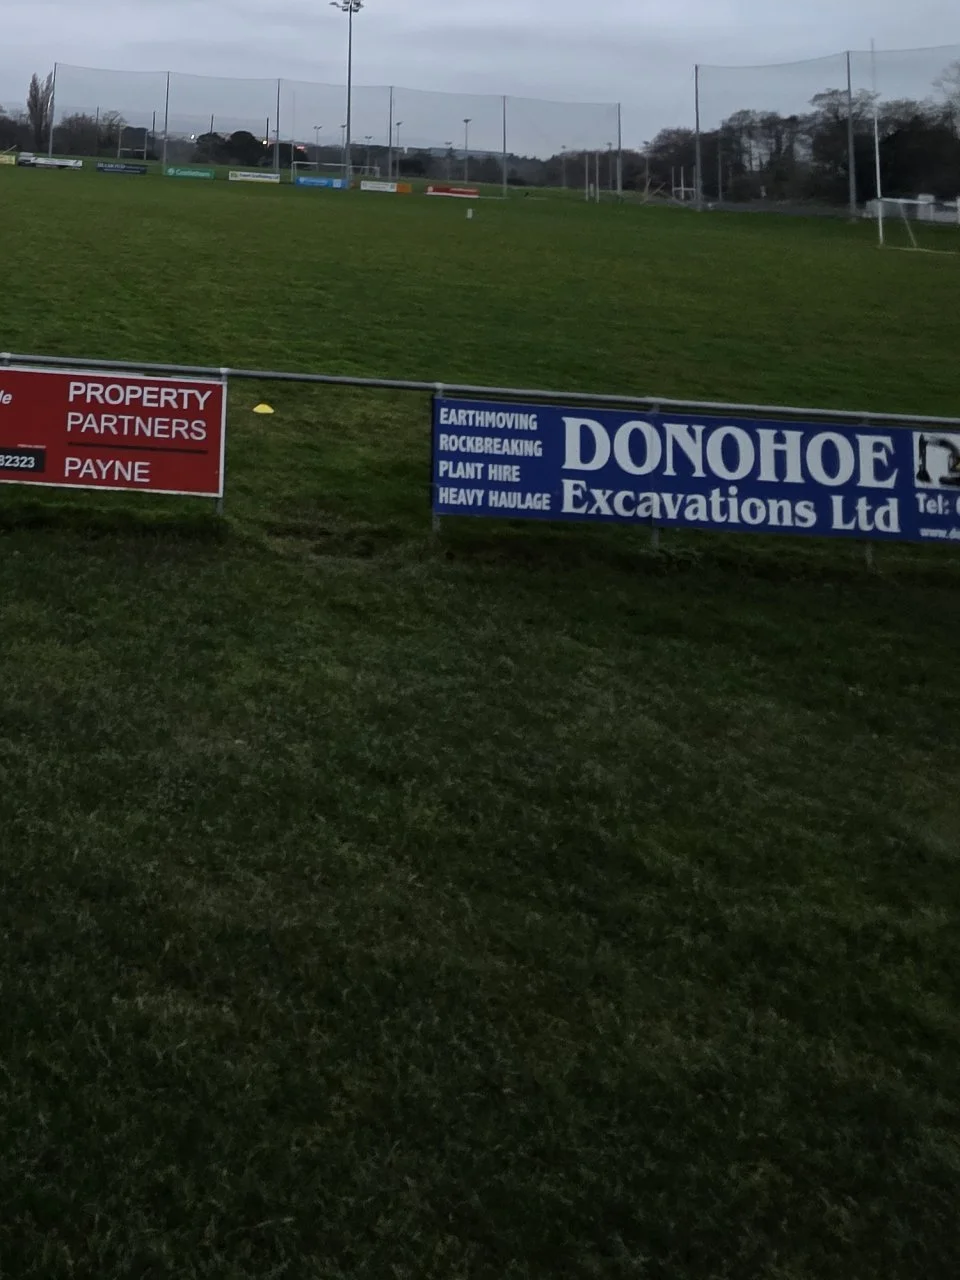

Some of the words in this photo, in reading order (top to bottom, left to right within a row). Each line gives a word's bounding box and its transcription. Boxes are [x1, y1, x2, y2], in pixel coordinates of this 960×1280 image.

[68, 382, 212, 410] PROPERTY
[67, 412, 207, 441] PARTNERS
[439, 407, 538, 431] EARTHMOVING
[439, 433, 543, 458] ROCKBREAKING
[561, 416, 898, 488] DONOHOE
[64, 457, 151, 483] PAYNE
[439, 461, 483, 480] PLANT
[488, 464, 520, 482] HIRE
[439, 486, 485, 507] HEAVY
[488, 490, 551, 511] HAULAGE
[561, 479, 817, 528] Excavations
[832, 494, 902, 533] Ltd
[916, 492, 950, 514] Tel:
